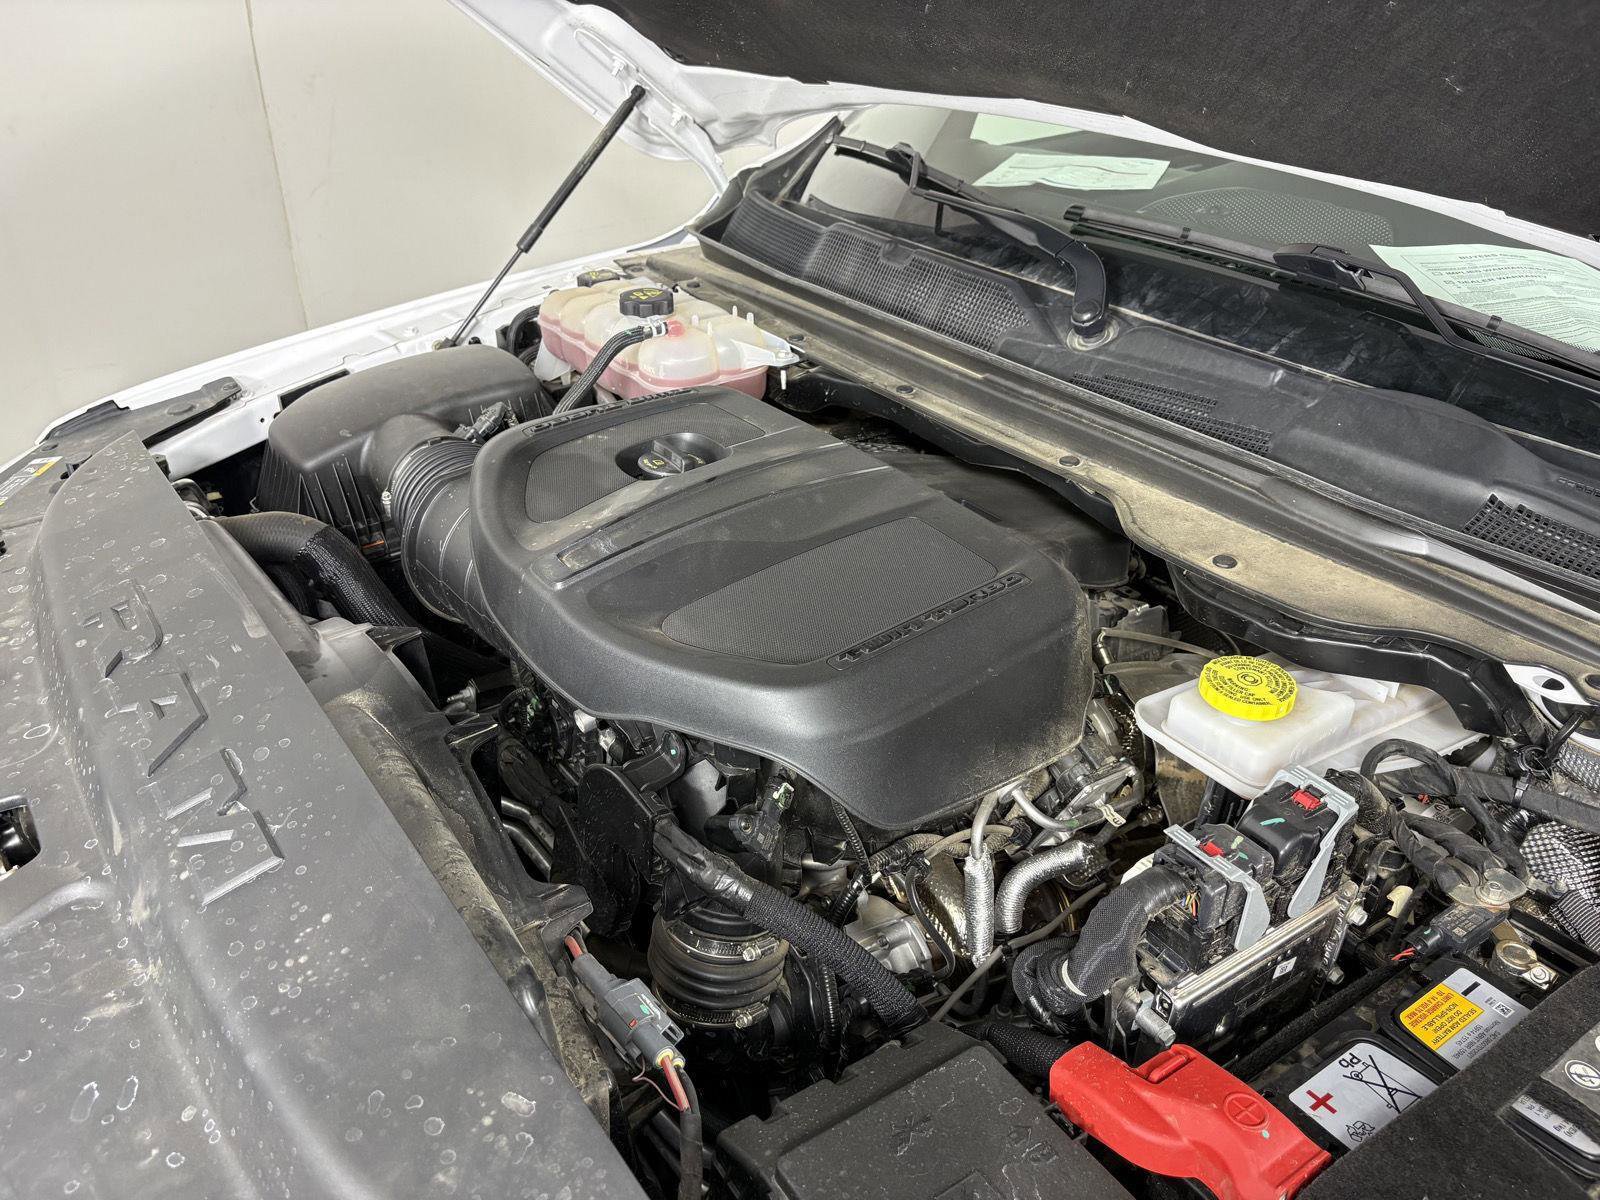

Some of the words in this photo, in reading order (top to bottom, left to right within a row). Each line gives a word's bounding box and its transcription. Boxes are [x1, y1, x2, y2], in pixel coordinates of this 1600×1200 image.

[83, 578, 285, 907] RAM
[1444, 1014, 1456, 1023] NOT
[1452, 1009, 1462, 1017] DO
[1457, 1008, 1477, 1023] SEALED
[1449, 1020, 1461, 1030] AGM
[1430, 1027, 1452, 1045] BATTERY
[1338, 1052, 1362, 1068] Pb
